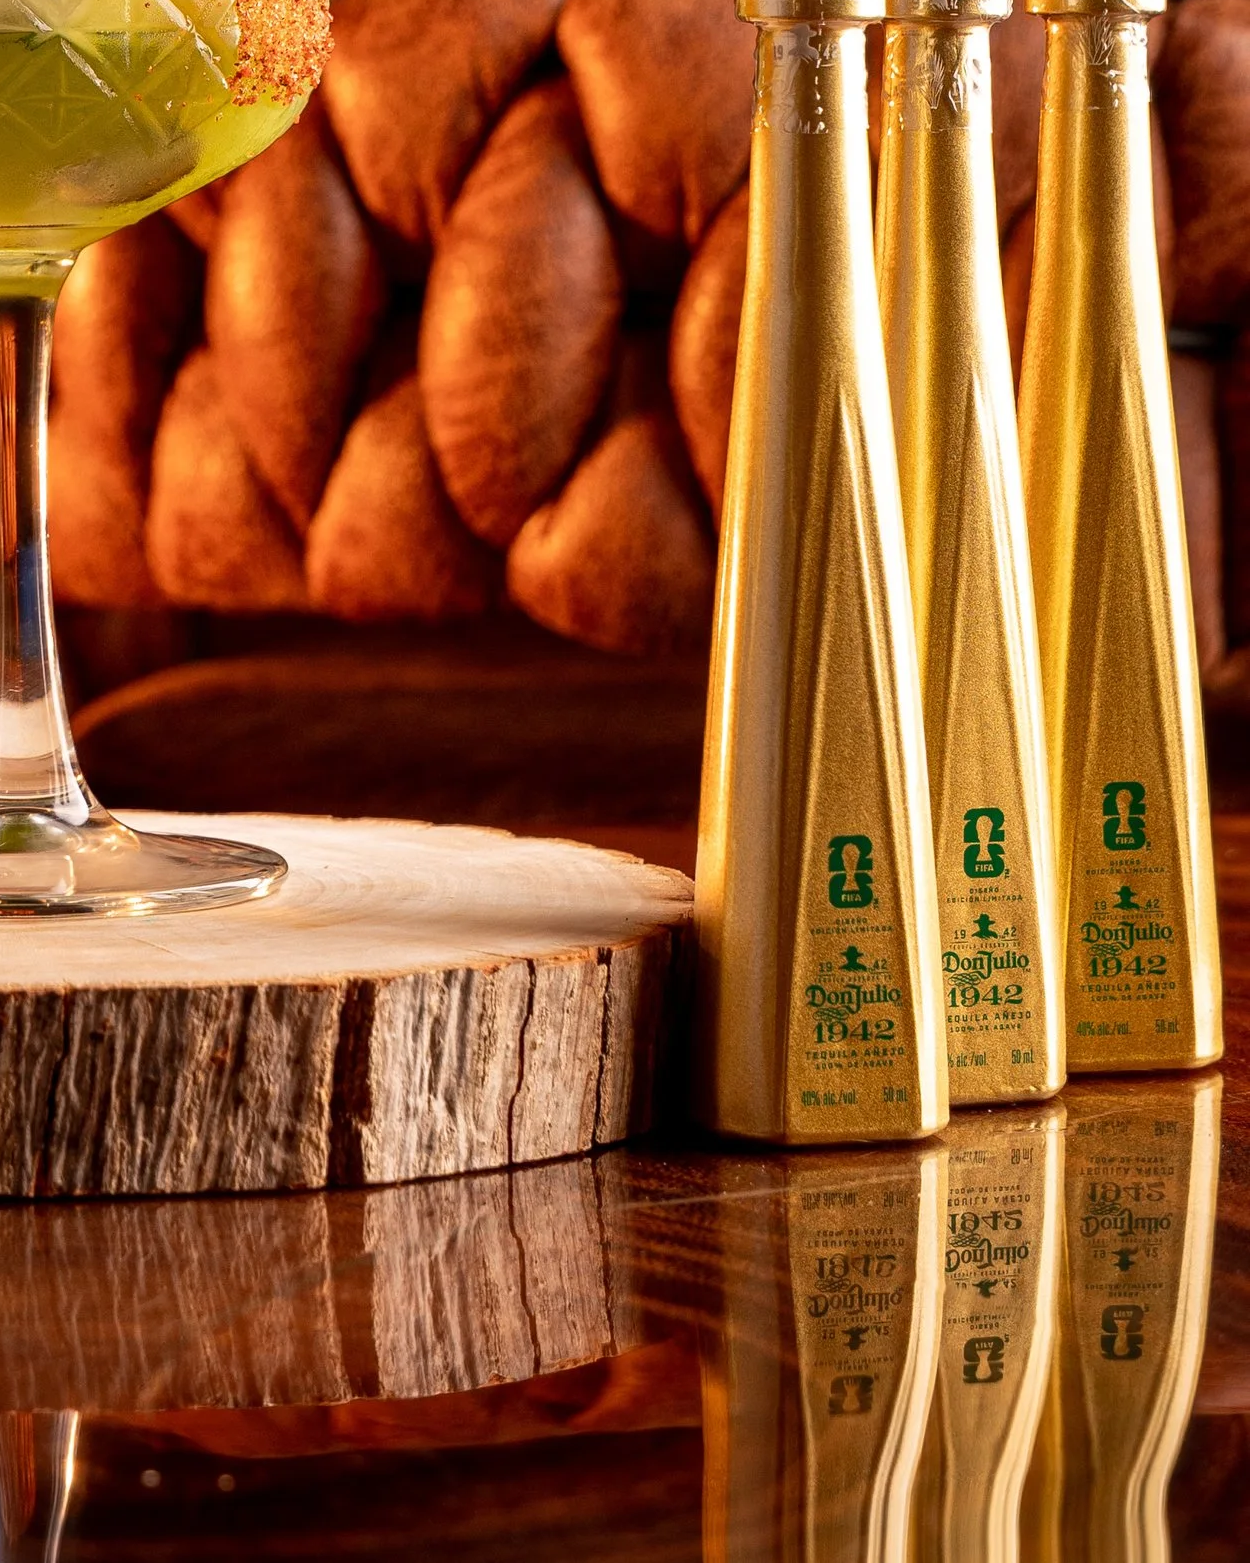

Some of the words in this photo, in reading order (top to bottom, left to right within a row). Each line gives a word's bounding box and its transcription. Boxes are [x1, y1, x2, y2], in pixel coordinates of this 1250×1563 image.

[1115, 837, 1136, 845] FIFA
[975, 864, 994, 872] FIFA
[842, 894, 862, 902] FIFA
[983, 894, 1023, 902] LIMITADA
[1094, 900, 1107, 910] 19
[954, 929, 967, 940] 19
[1003, 926, 1017, 937] 42
[819, 961, 833, 972] 19
[873, 959, 888, 970] 42
[1088, 955, 1167, 978] 1942
[1080, 983, 1131, 993] TEQUILA
[1137, 980, 1176, 991] AÑEJO
[948, 984, 1023, 1008] 1942
[947, 1013, 989, 1024] EQUILA
[995, 1010, 1032, 1021] AÑEJO
[813, 1019, 895, 1044] 1942
[950, 1025, 975, 1033] 100%
[805, 1049, 857, 1060] TEQUILA
[864, 1046, 905, 1057] AÑEJO
[956, 1051, 989, 1067] alc./vol.
[1011, 1048, 1021, 1064] 50
[801, 1090, 820, 1106] 40%
[882, 1086, 894, 1102] 50
